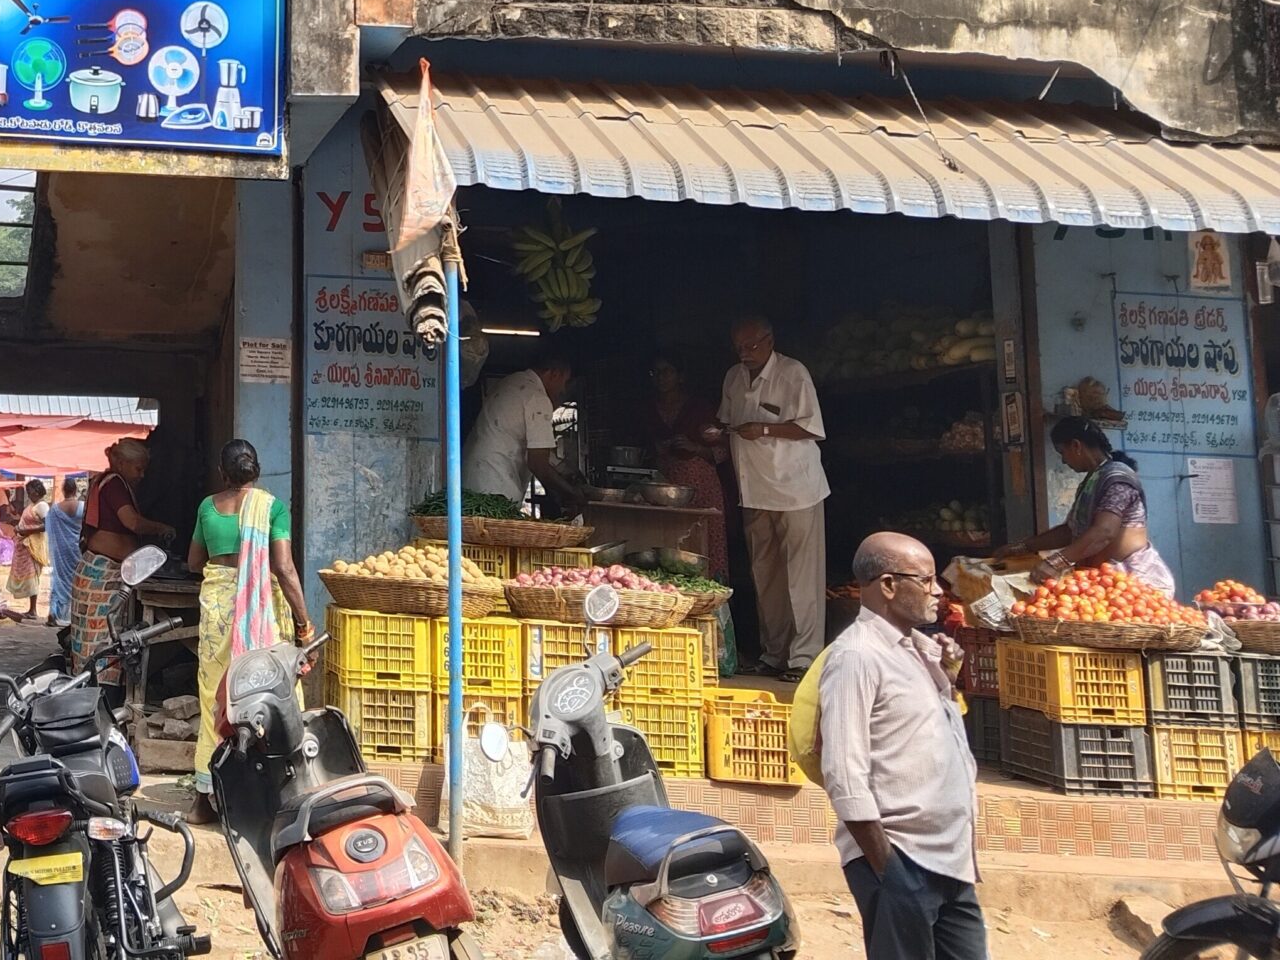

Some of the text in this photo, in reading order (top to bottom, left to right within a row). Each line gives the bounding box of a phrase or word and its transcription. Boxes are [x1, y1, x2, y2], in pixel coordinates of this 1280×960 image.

[1119, 336, 1239, 374] కూరగాయల షాపు
[357, 838, 373, 848] TVS
[616, 913, 655, 938] Pleasure
